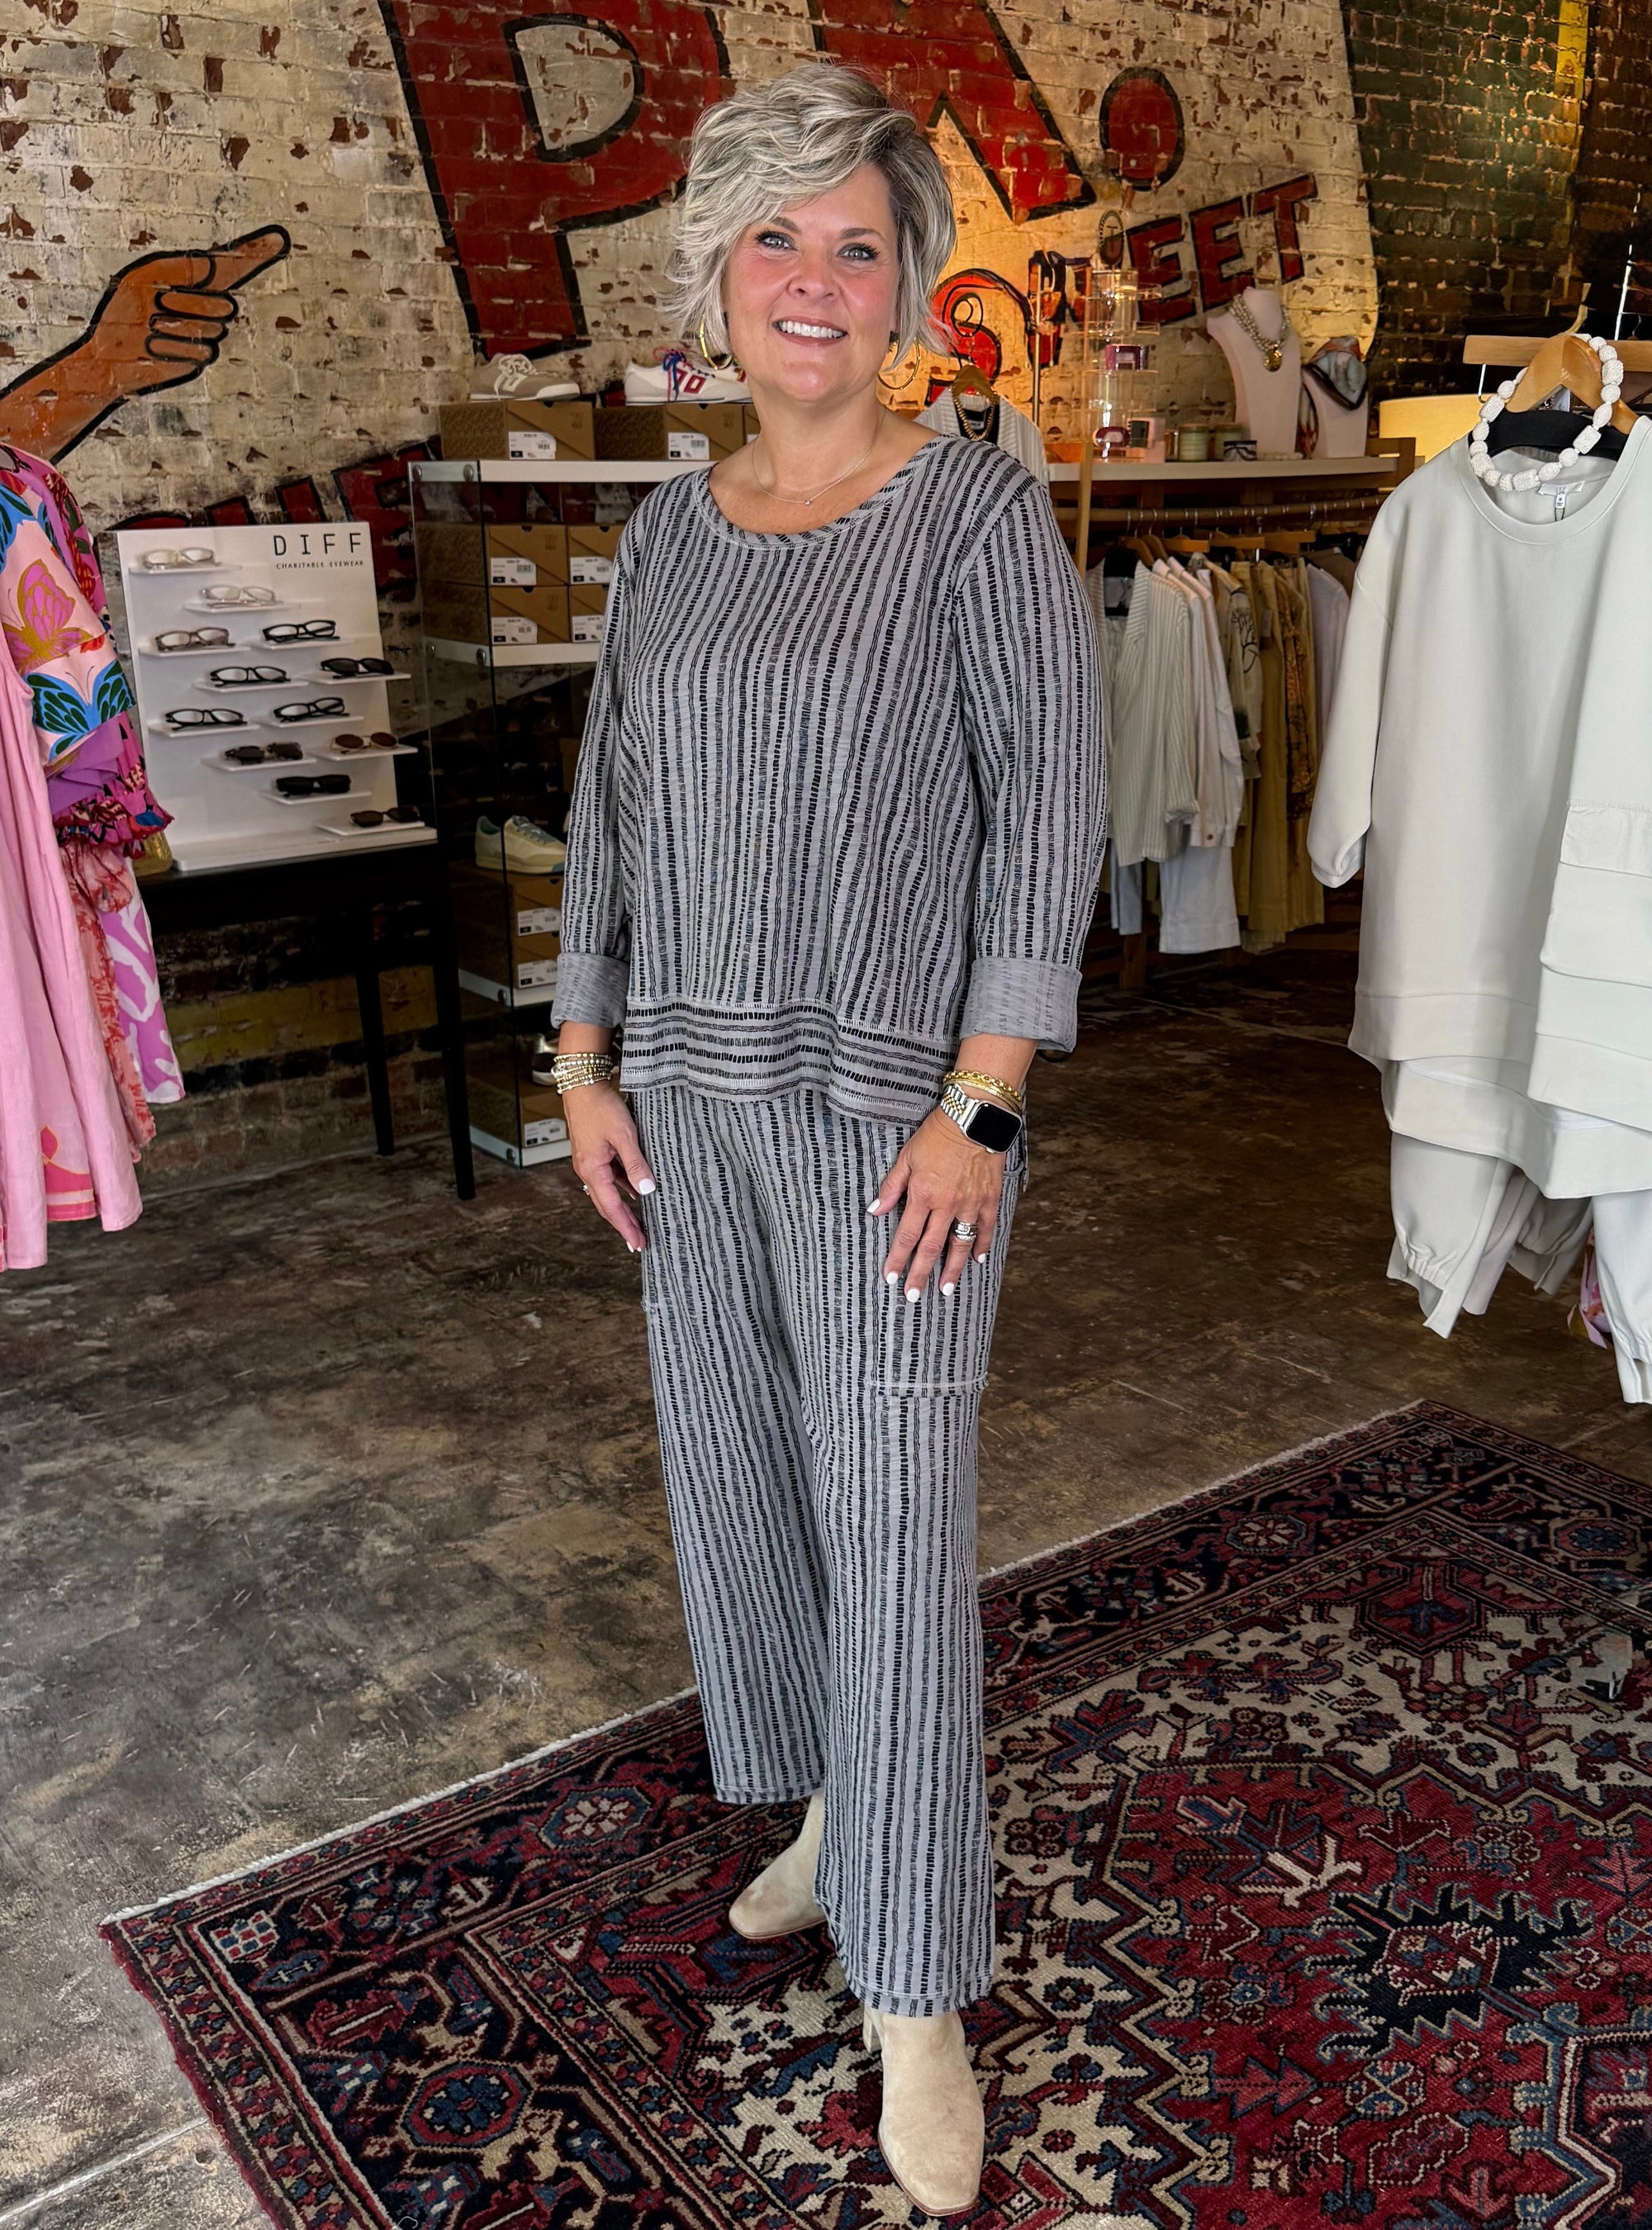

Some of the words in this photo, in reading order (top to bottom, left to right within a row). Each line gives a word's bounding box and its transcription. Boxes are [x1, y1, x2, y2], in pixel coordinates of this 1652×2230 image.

[273, 533, 362, 556] DIFF
[276, 562, 324, 570] CHARITABLE
[330, 560, 364, 568] EYEWEAR
